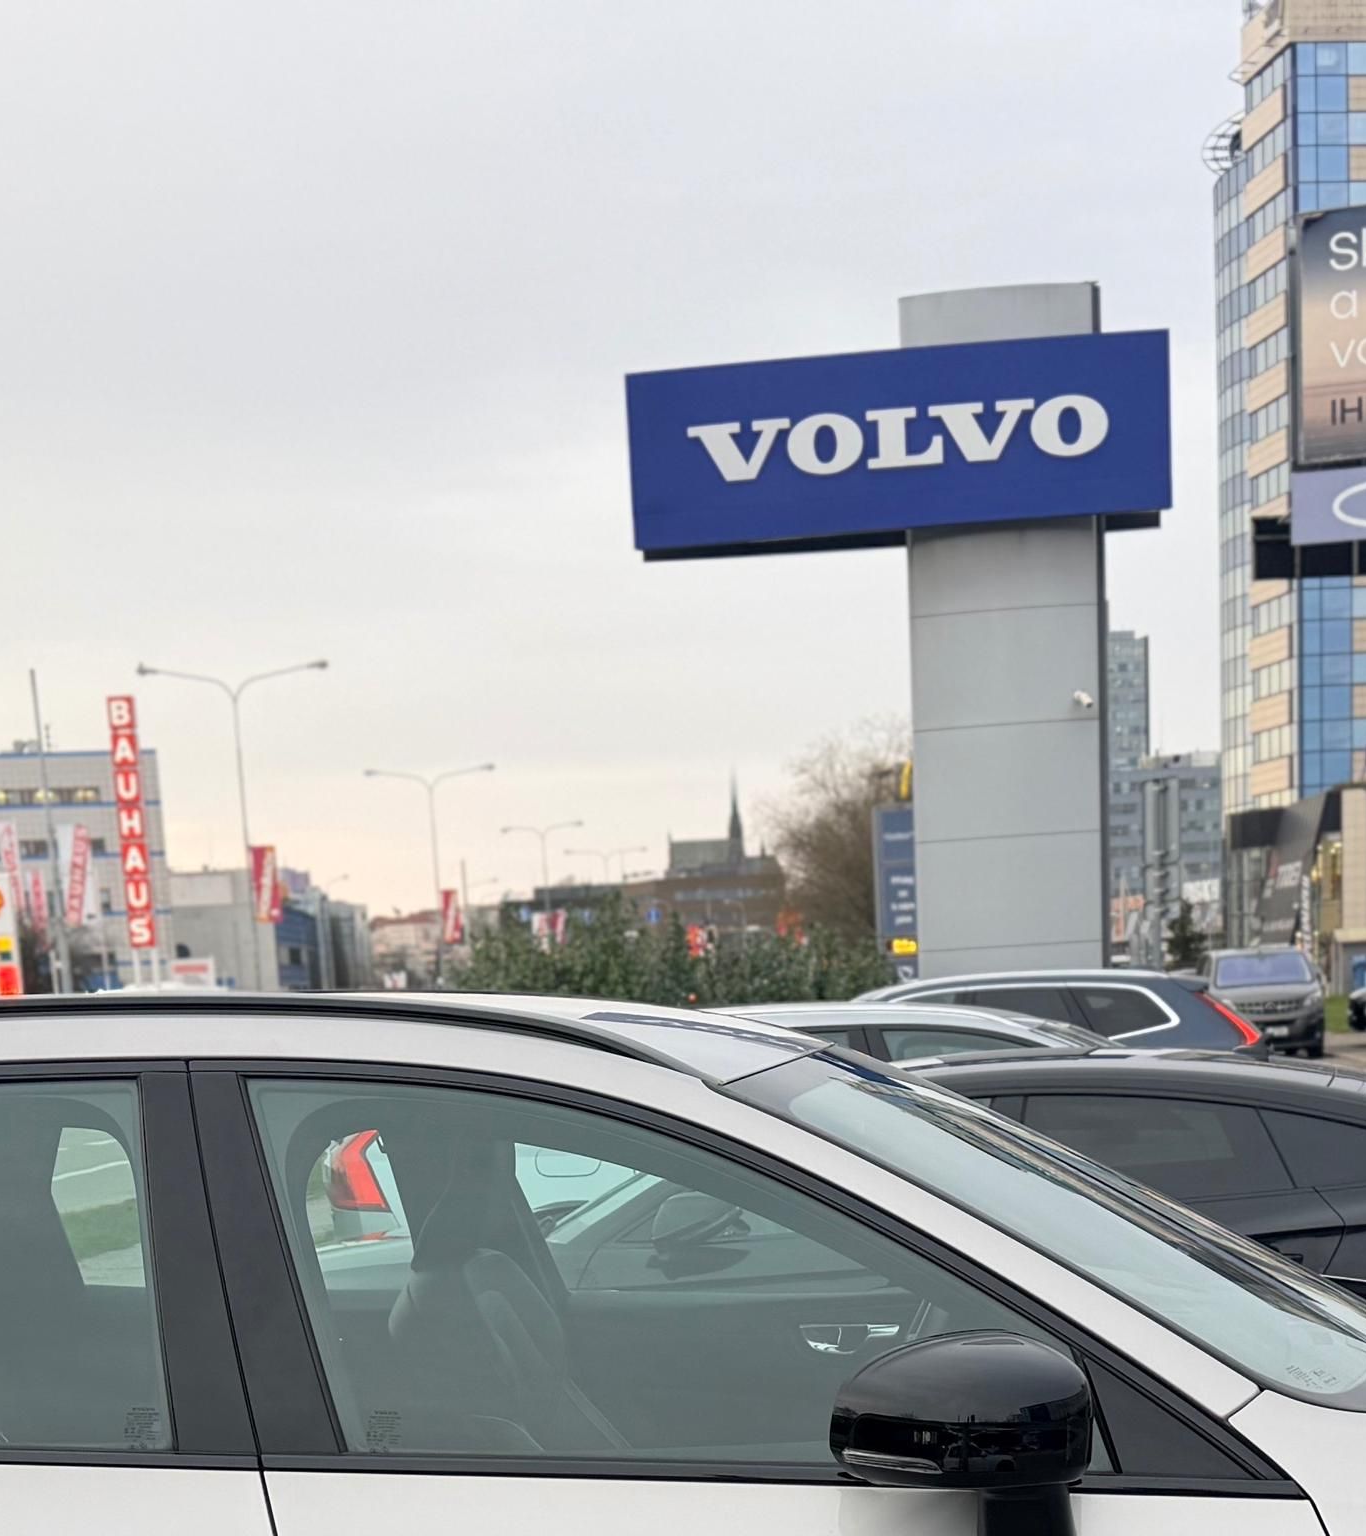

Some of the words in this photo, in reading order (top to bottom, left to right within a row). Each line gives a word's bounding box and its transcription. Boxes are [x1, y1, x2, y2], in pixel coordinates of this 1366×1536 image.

[1329, 289, 1358, 320] a
[687, 393, 1110, 482] VOLVO
[110, 698, 153, 945] BAUHAUS
